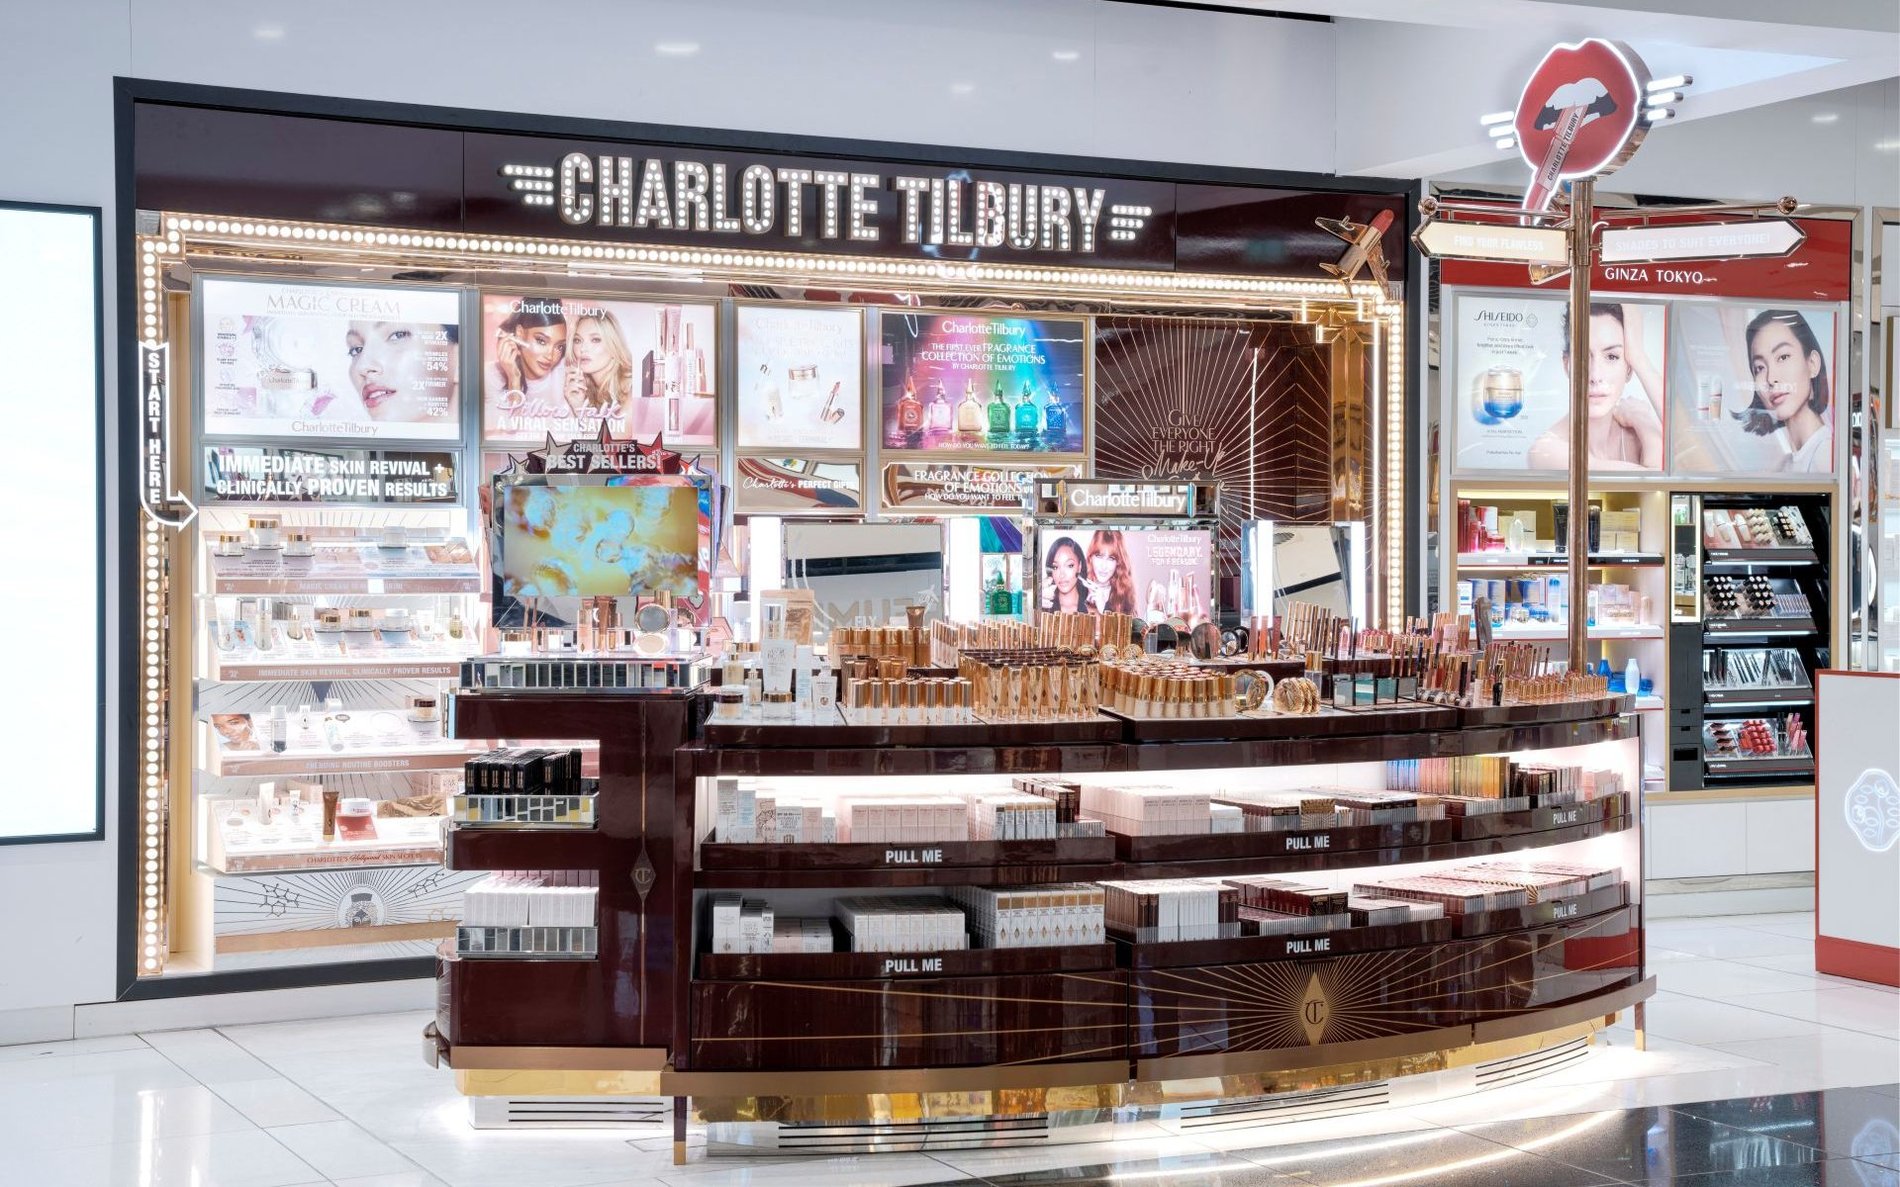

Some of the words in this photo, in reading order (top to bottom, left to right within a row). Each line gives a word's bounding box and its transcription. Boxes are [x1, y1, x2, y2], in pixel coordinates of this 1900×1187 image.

[1547, 142, 1568, 181] CHARLOTTE
[1563, 113, 1579, 142] TILBURY
[560, 152, 879, 241] CHARLOTTE
[897, 177, 1106, 251] TILBURY
[1615, 238, 1659, 252] SHADES
[1662, 238, 1676, 249] TO
[1680, 237, 1704, 249] SUIT
[1708, 233, 1770, 247] EVERYONE!
[1604, 267, 1648, 282] GINZA
[1656, 269, 1703, 284] TOKYO
[267, 294, 329, 312] MAGIC
[336, 296, 400, 314] CREAM
[510, 299, 608, 320] CharlotteTilbury
[1473, 310, 1523, 322] SHISEIDO
[942, 320, 1026, 338] CharlotteTilbury
[932, 343, 945, 351] THE
[946, 343, 963, 351] FIRST
[983, 342, 1036, 354] FRAGRANCE
[921, 351, 981, 362] COLLECTION
[982, 352, 994, 363] OF
[997, 353, 1046, 365] EMOTIONS
[148, 352, 161, 433] START
[291, 421, 378, 436] CharlotteTilbury
[497, 417, 505, 430] A
[511, 417, 546, 430] VIRAL
[555, 418, 625, 432] SENSATON
[1152, 426, 1216, 440] EVERYONE
[573, 443, 635, 453] CHARLOTTE'S
[1152, 440, 1176, 453] THE
[1178, 440, 1216, 453] RIGHT
[218, 455, 325, 473] IMMEDIATE
[329, 460, 364, 474] SKIN
[370, 461, 430, 475] REVIVAL
[546, 454, 586, 469] BEST
[591, 454, 661, 469] SELLERS!
[148, 438, 161, 504] HERE
[914, 470, 980, 482] FRAGRANCE
[982, 470, 1051, 482] COLLECTION
[216, 479, 302, 496] CLINICALLY
[307, 478, 380, 496] PROVEN
[385, 482, 448, 497] RESULTS
[742, 476, 796, 489] Charlotte's
[798, 480, 831, 489] PERFECT
[944, 482, 958, 493] OF
[963, 482, 1022, 493] EMOTIONS
[1070, 488, 1186, 512] CharlotteTilbury
[421, 666, 451, 674] RESULTS
[1553, 811, 1567, 824] PULL
[1567, 810, 1577, 822] ME
[1286, 837, 1311, 850] PULL
[1314, 836, 1330, 849] ME
[885, 850, 918, 863] PULL
[922, 849, 943, 863] ME
[1553, 906, 1567, 918] PULL
[1567, 904, 1577, 916] ME
[1286, 940, 1311, 953] PULL
[1314, 938, 1330, 951] ME
[885, 959, 918, 972] PULL
[922, 958, 943, 971] ME
